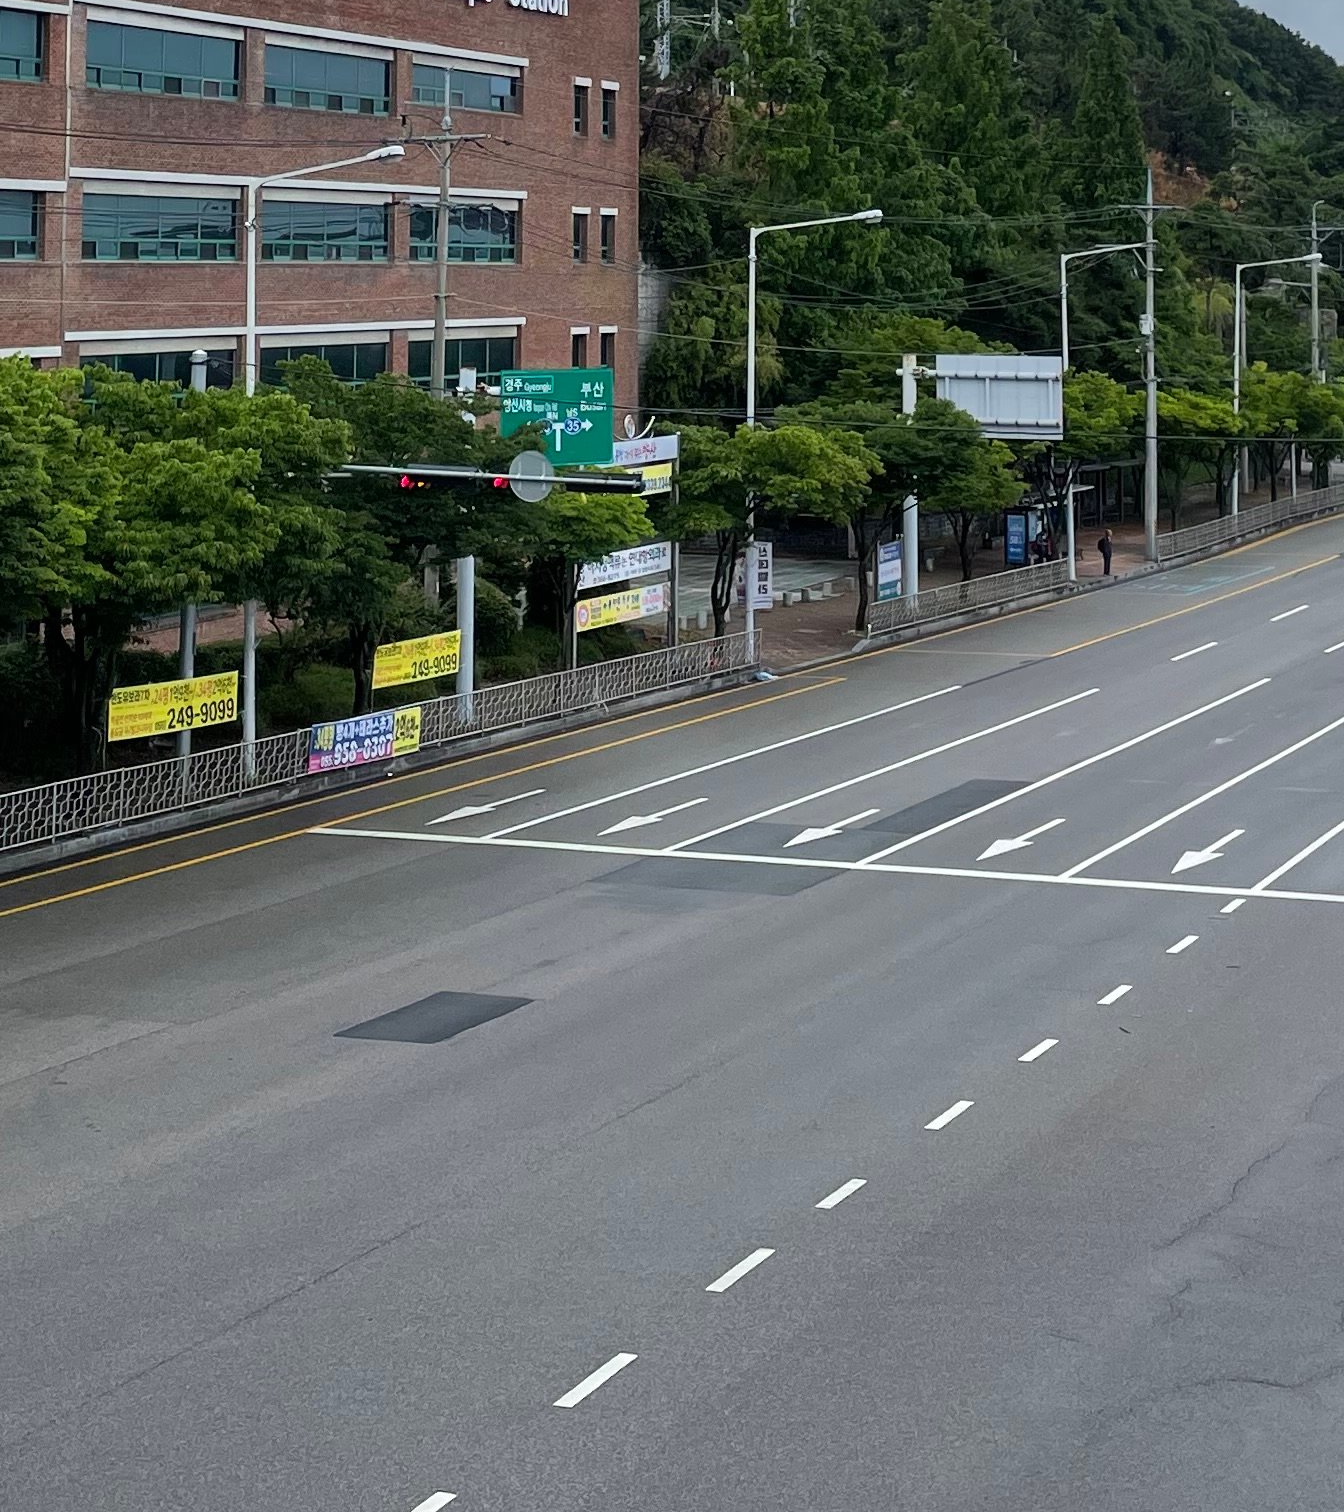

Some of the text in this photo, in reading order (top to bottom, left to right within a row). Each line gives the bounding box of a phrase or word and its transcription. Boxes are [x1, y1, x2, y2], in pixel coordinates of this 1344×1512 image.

[504, 378, 523, 392] 경주
[580, 381, 605, 398] 부산
[566, 421, 581, 432] 35
[167, 697, 235, 730] 249-9099
